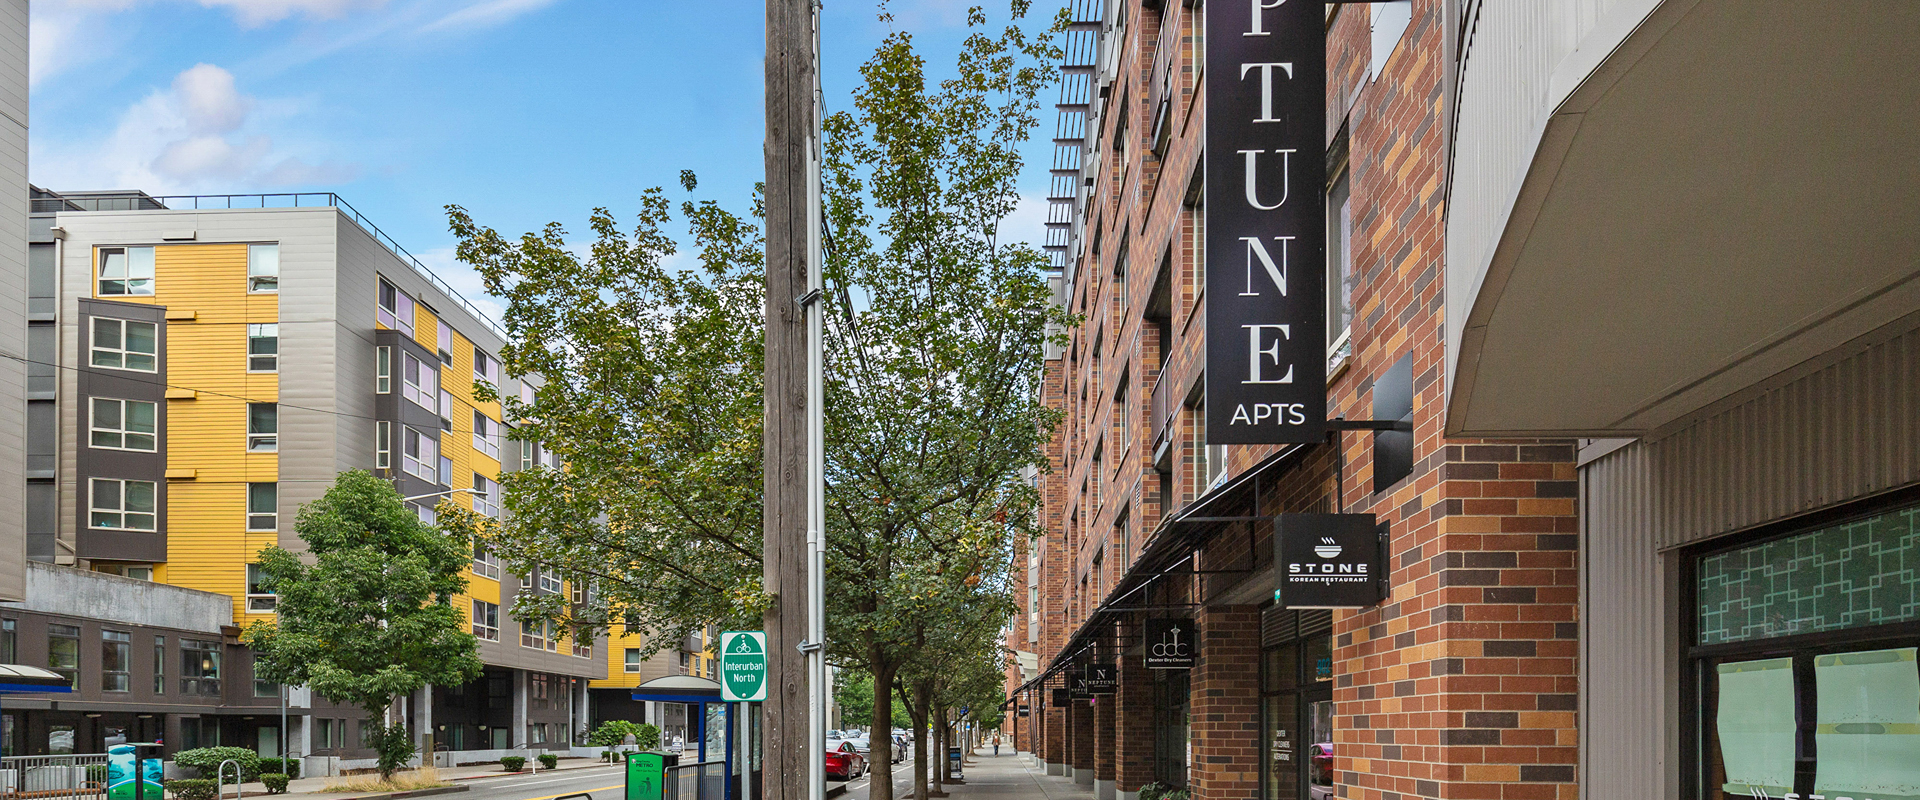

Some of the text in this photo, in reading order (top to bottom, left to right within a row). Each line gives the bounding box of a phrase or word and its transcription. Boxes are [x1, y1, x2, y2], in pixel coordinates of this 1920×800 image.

[1230, 403, 1306, 426] APTS
[1289, 563, 1368, 573] STONE
[725, 662, 763, 671] Interurban
[733, 674, 756, 682] North
[1096, 669, 1106, 679] N
